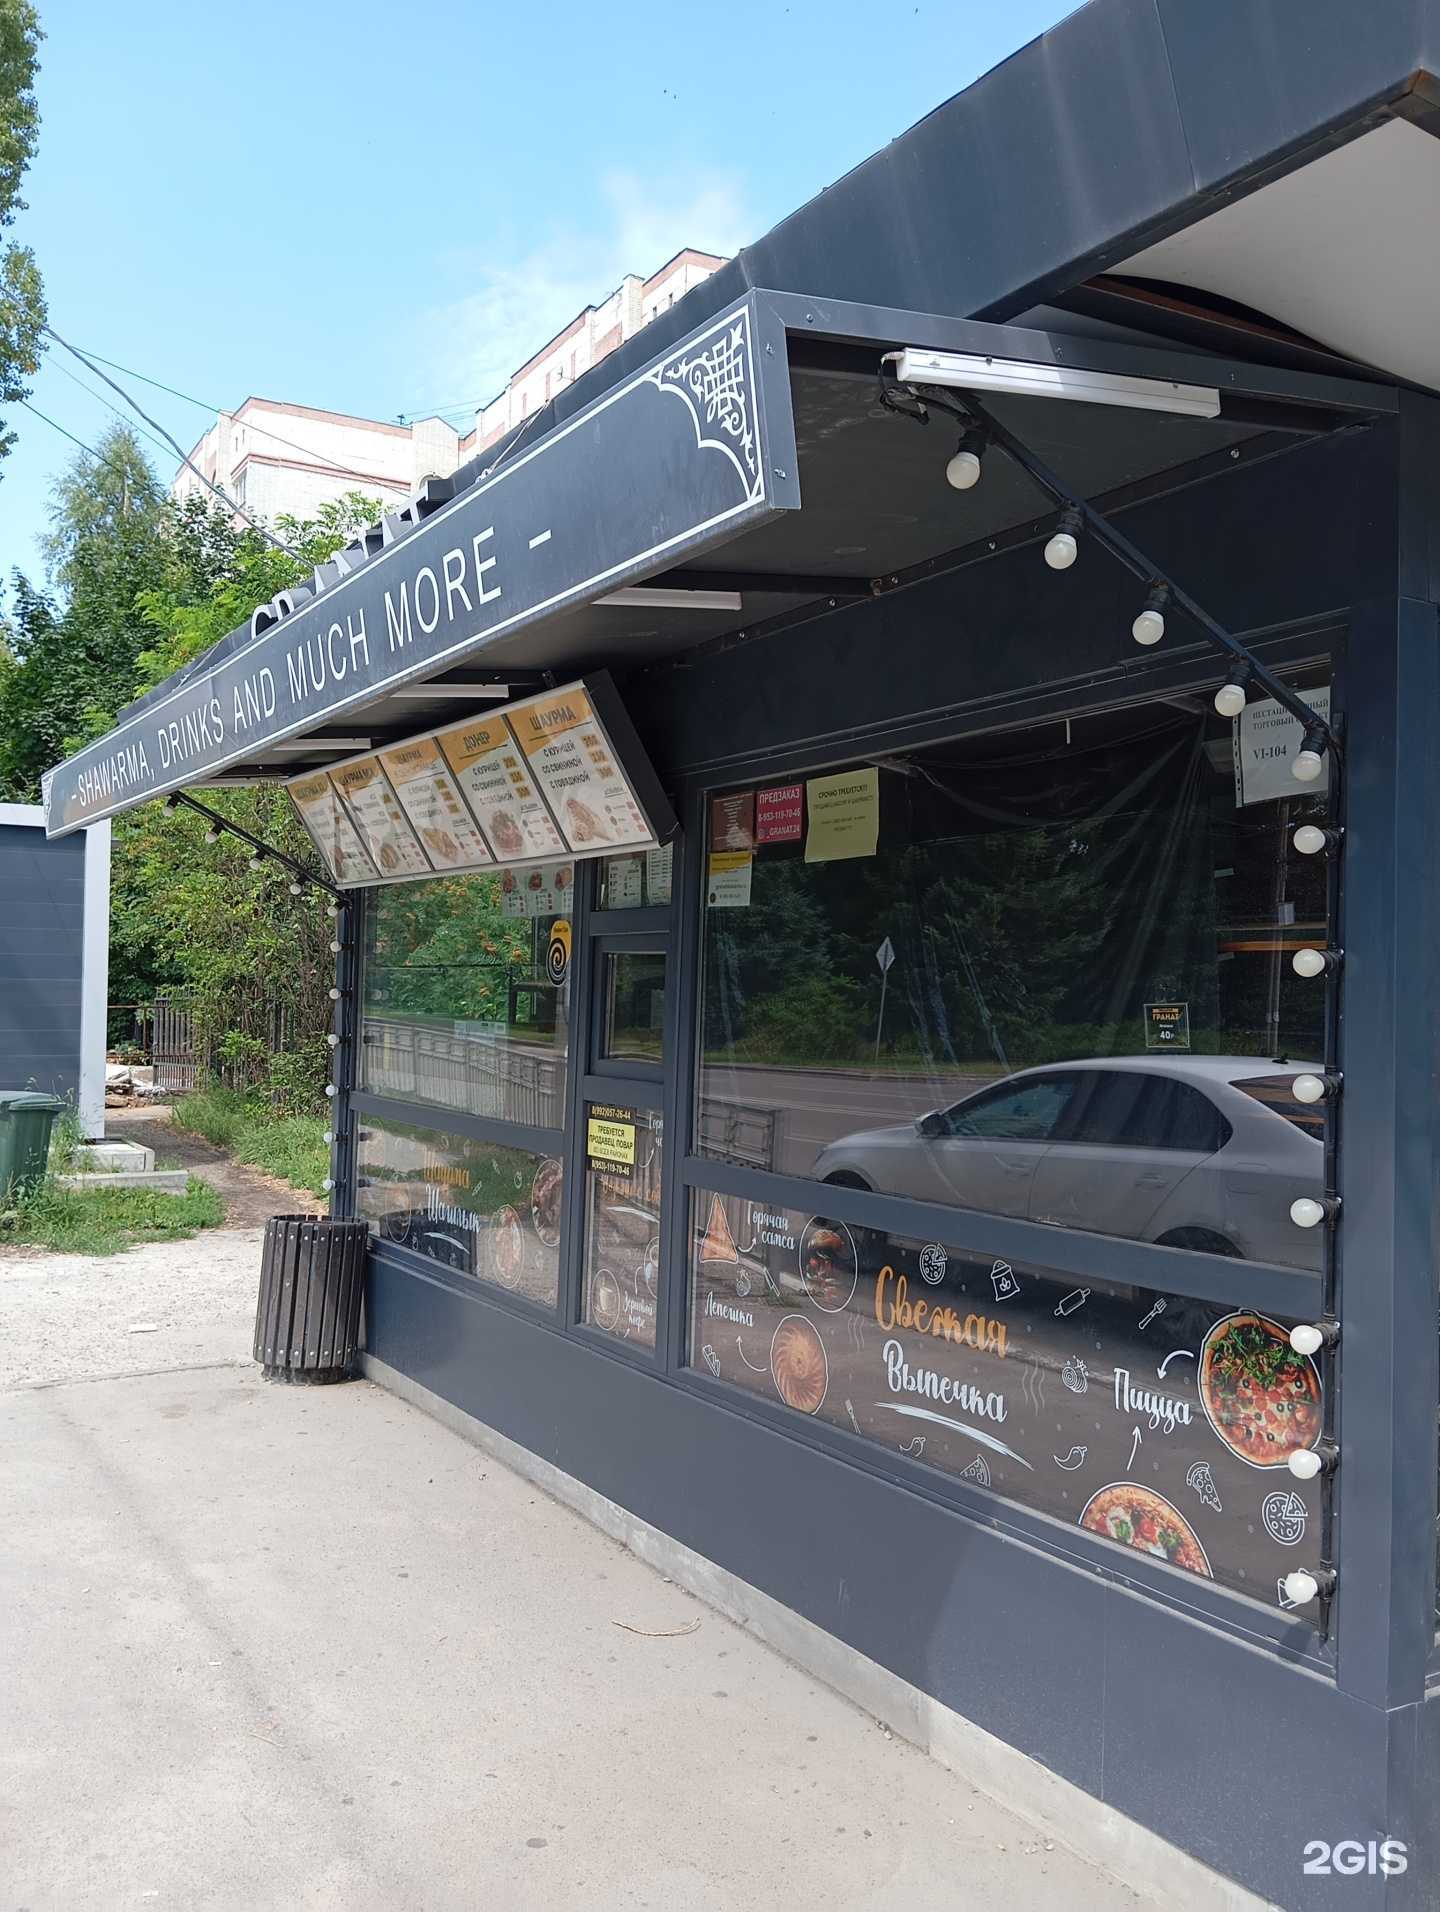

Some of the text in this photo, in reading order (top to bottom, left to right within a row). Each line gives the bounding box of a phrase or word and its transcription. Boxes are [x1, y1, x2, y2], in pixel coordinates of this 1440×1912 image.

[78, 740, 155, 807] SHAWARMA,
[158, 698, 224, 769] DRINKS
[233, 667, 277, 734] AND
[286, 608, 370, 704] MUCH
[384, 526, 502, 652] MORE
[529, 705, 577, 731] ШАУРМА
[1253, 745, 1287, 760] VI-104
[759, 787, 800, 804] ПРЕДЗАКАЗ
[597, 1125, 625, 1138] ТРЕБУЕТСЯ
[616, 1140, 633, 1150] ПОВАР
[747, 1201, 789, 1234] Горячая
[761, 1230, 796, 1250] самса
[874, 1265, 1010, 1359] Свежая
[882, 1339, 1009, 1423] Выпечка
[1114, 1367, 1194, 1434] Пицца
